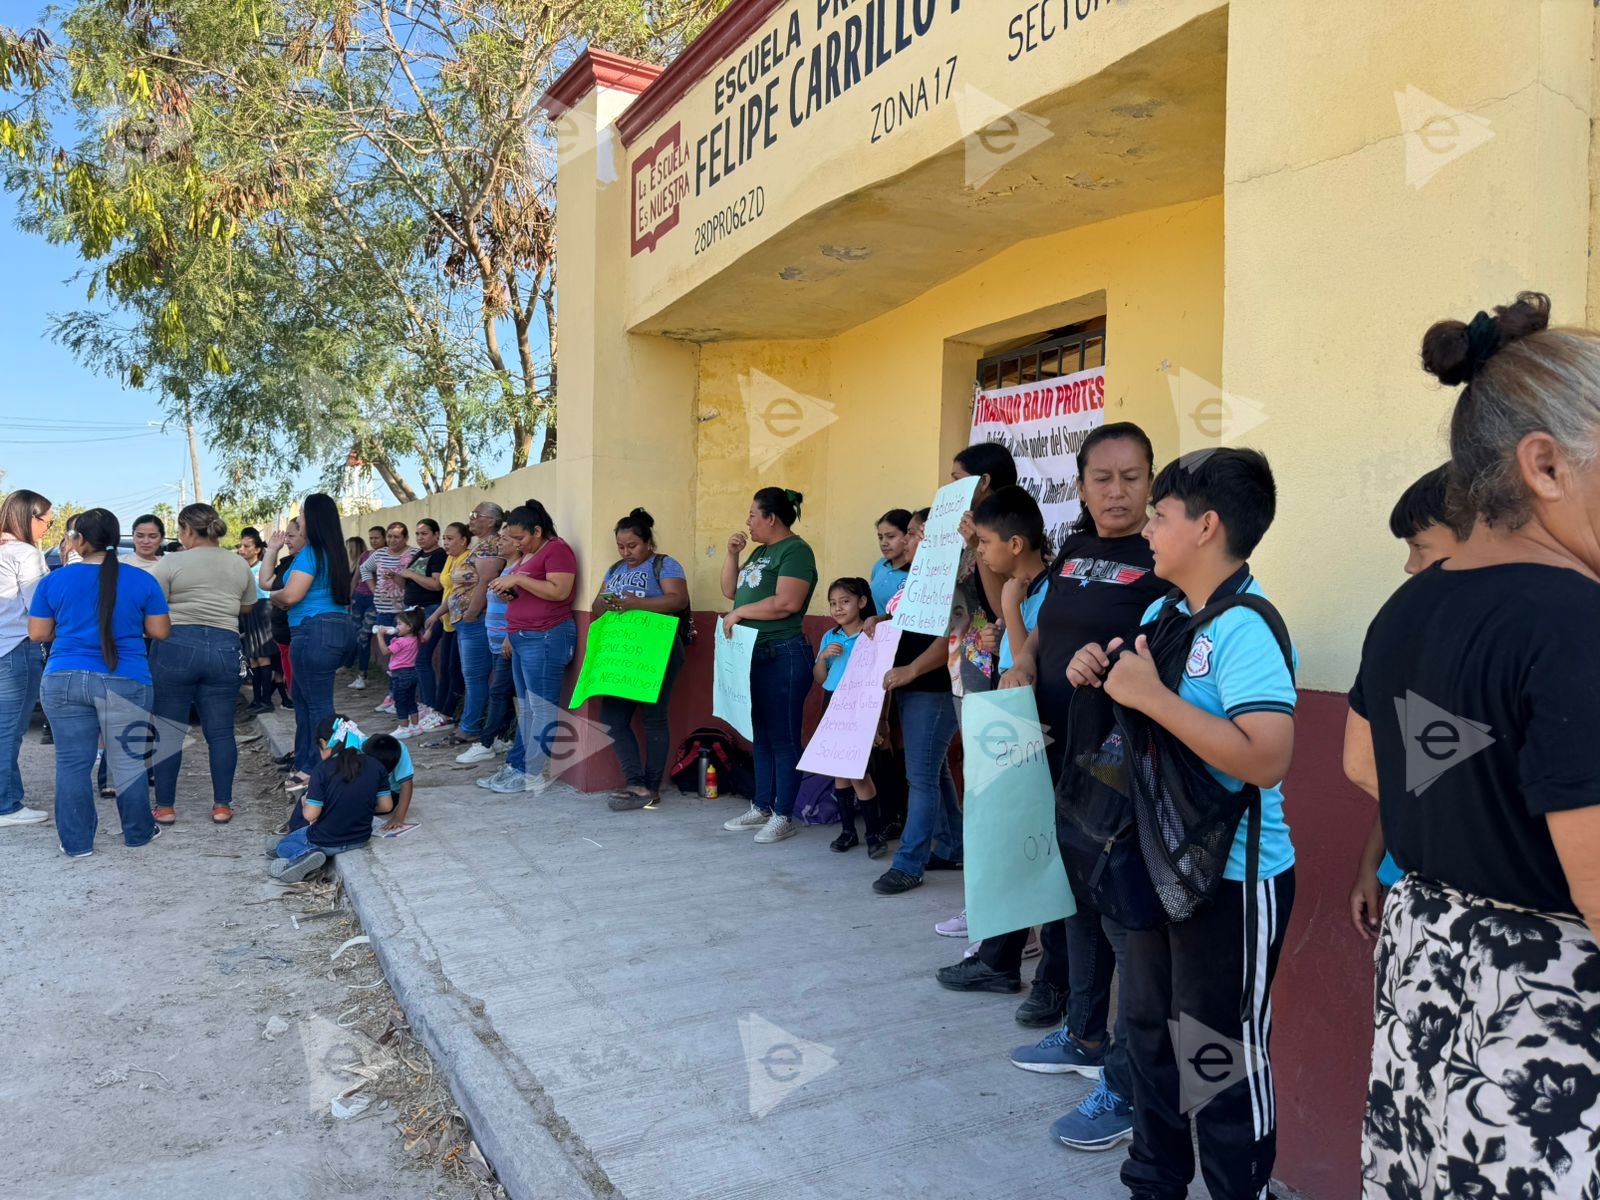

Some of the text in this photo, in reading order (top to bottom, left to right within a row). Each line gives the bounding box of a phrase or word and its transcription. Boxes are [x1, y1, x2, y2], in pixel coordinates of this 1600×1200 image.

[1008, 0, 1111, 62] SECT
[714, 9, 801, 116] ESCUELA
[870, 55, 958, 144] ZONA 17
[695, 77, 780, 197] FELIPE
[650, 140, 690, 191] ESCUELA
[650, 171, 690, 223] NUESTRA
[1023, 387, 1054, 422] BAJO
[1029, 429, 1048, 460] poder
[1050, 426, 1062, 456] del
[1063, 421, 1094, 456] Super
[911, 558, 925, 576] el
[897, 613, 916, 627] nos
